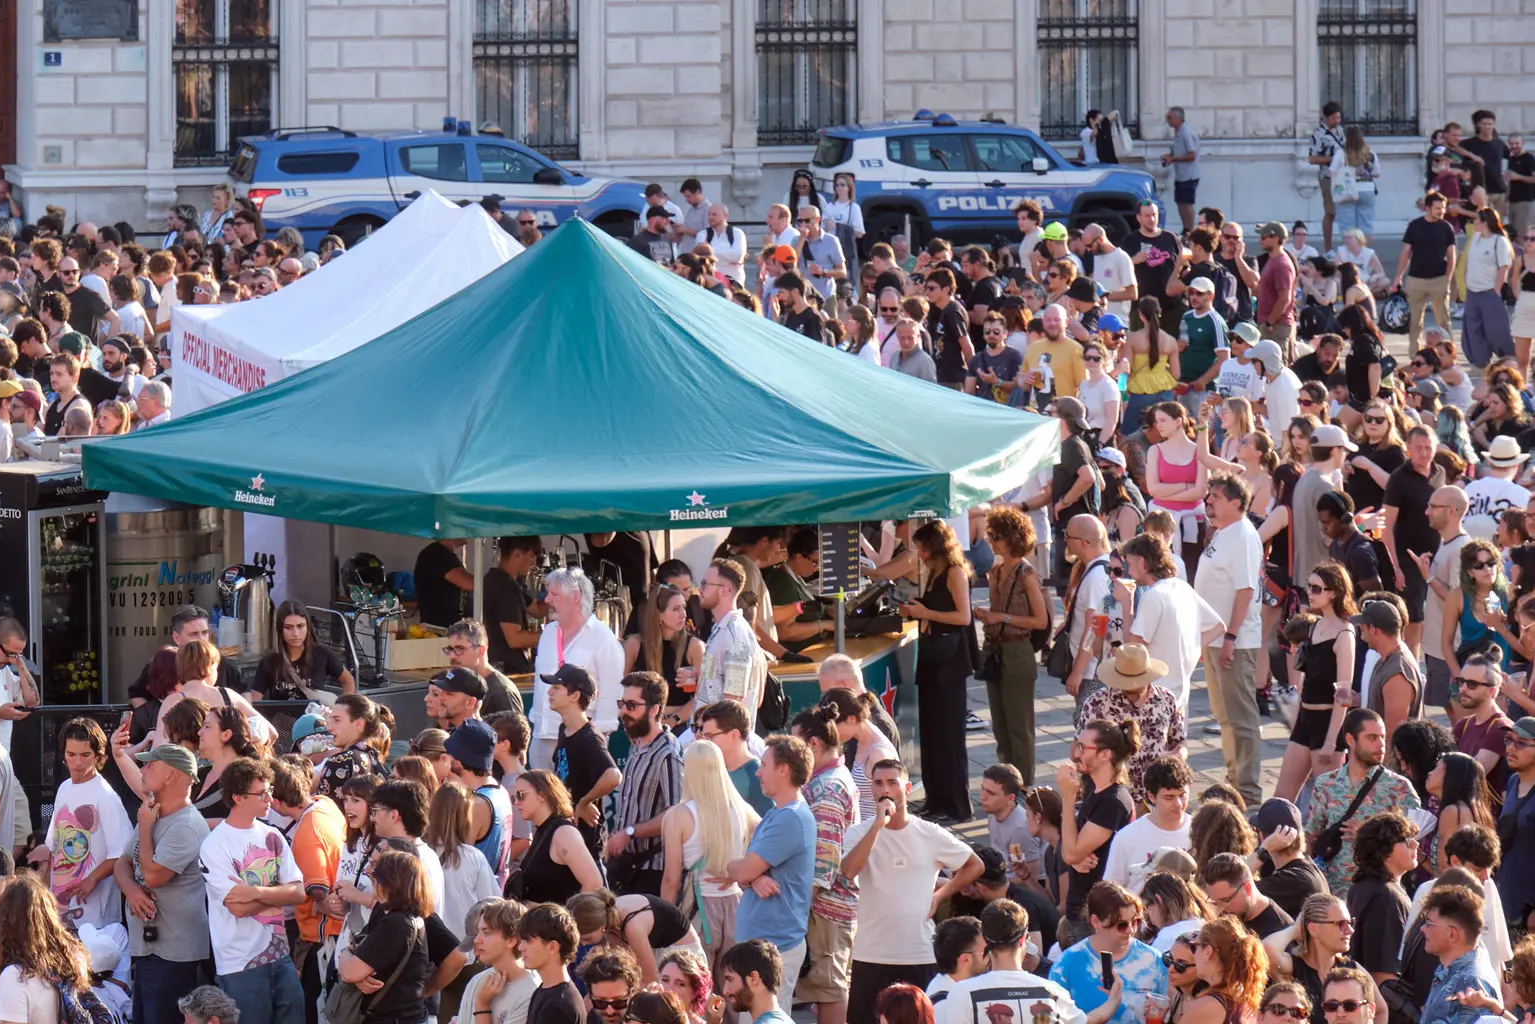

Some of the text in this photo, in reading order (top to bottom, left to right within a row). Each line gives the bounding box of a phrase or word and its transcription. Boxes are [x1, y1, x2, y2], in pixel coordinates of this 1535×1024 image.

[49, 54, 57, 63] 1
[859, 160, 884, 168] 113
[284, 188, 309, 198] 113
[182, 331, 266, 393] OFFICIAL MERCHANDISE
[234, 490, 276, 507] Heineken
[669, 508, 728, 521] Heineken
[109, 560, 216, 590] grini Noleggi
[109, 592, 126, 607] VU
[109, 626, 126, 637] FOR
[134, 626, 156, 637] FOOD
